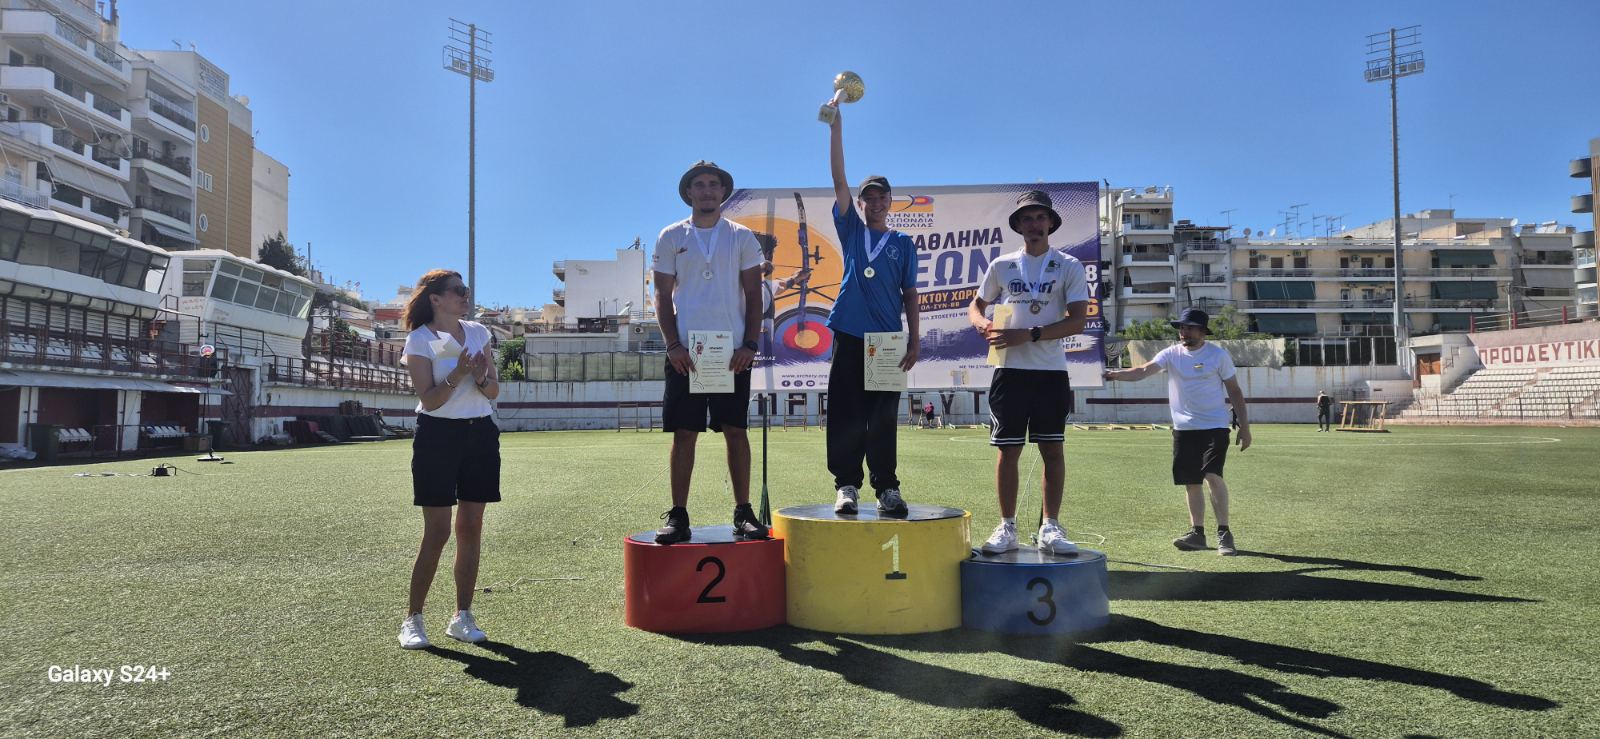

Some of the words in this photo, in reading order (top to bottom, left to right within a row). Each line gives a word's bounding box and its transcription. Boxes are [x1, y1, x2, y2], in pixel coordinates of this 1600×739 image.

[911, 227, 1003, 251] ΑΘΛΗΜΑ
[1084, 321, 1104, 329] ΙΑΣ
[1478, 340, 1600, 365] ΠΡΟΟΔΕΥΤΙΚ
[882, 533, 907, 580] 1
[695, 556, 726, 603] 2
[1026, 576, 1057, 626] 3
